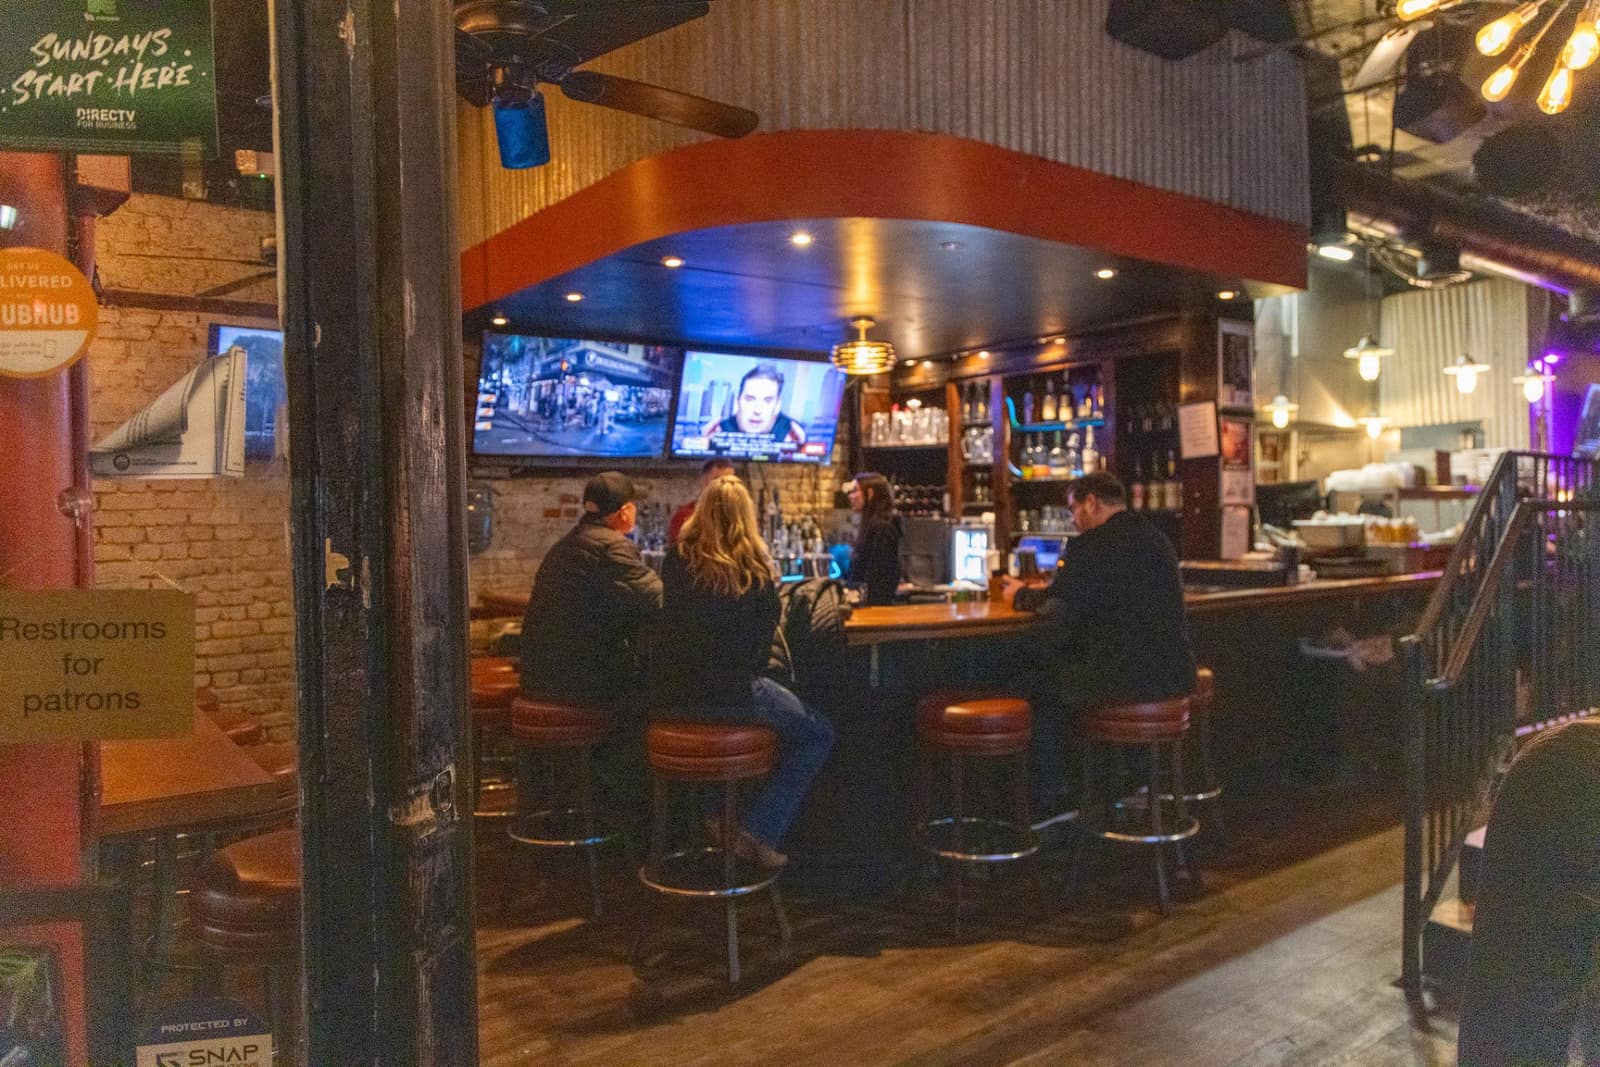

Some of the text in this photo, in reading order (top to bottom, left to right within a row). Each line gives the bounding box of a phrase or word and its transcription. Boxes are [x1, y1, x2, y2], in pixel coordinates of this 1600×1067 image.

[30, 27, 172, 67] SUNDAYS
[11, 62, 193, 106] START HERE
[76, 107, 136, 121] DIRECTV
[0, 617, 166, 641] Restrooms
[62, 652, 104, 676] for
[23, 689, 141, 717] patrons
[161, 1018, 249, 1033] PROTECTED BY
[188, 1044, 258, 1066] SNAP
